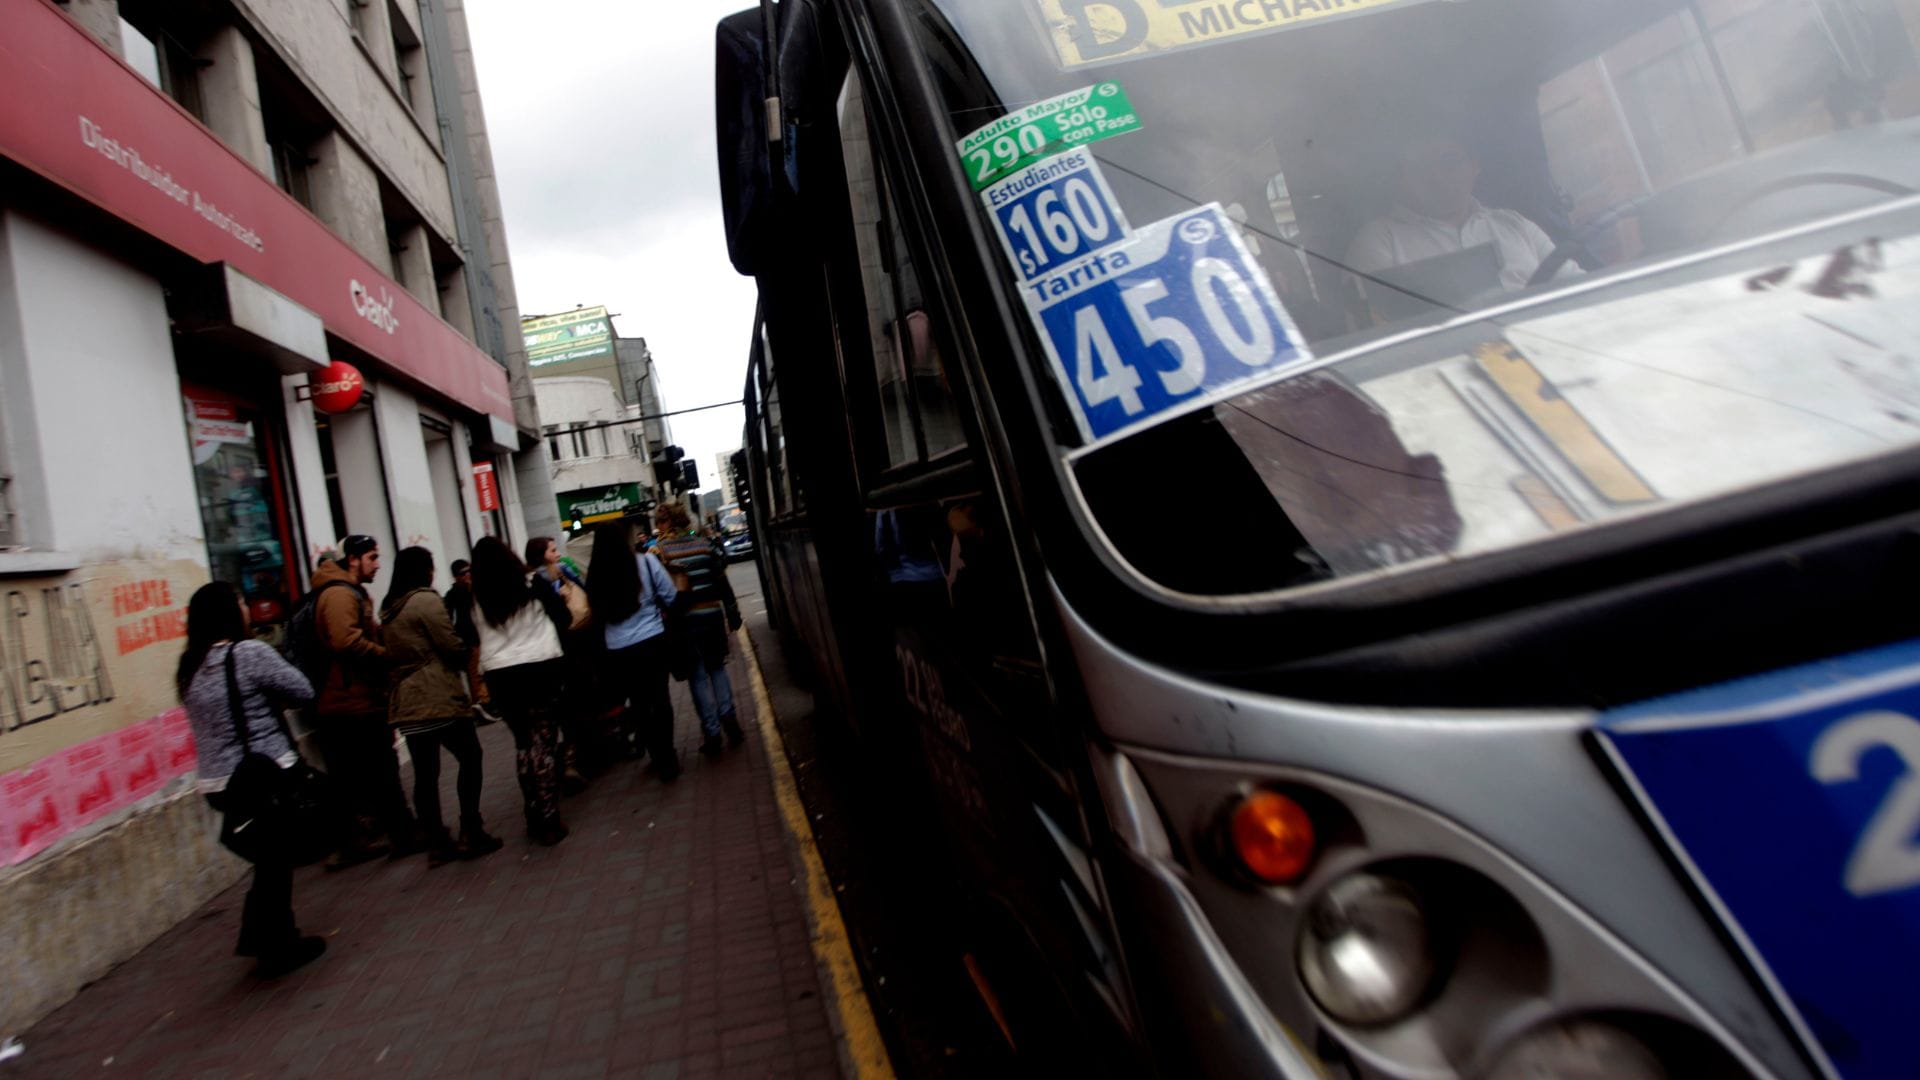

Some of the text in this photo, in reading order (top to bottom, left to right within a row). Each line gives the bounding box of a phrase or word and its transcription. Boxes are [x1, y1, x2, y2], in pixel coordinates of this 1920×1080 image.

[963, 92, 1087, 152] Adulto Mayor
[1054, 104, 1107, 132] Sólo
[1062, 113, 1137, 143] con Pase
[970, 124, 1047, 183] 290
[988, 152, 1086, 206] Estudiantes
[78, 114, 264, 254] Distribuidor Autorizado
[350, 279, 397, 335] Claro
[1074, 257, 1275, 417] 450
[311, 378, 355, 396] Claro
